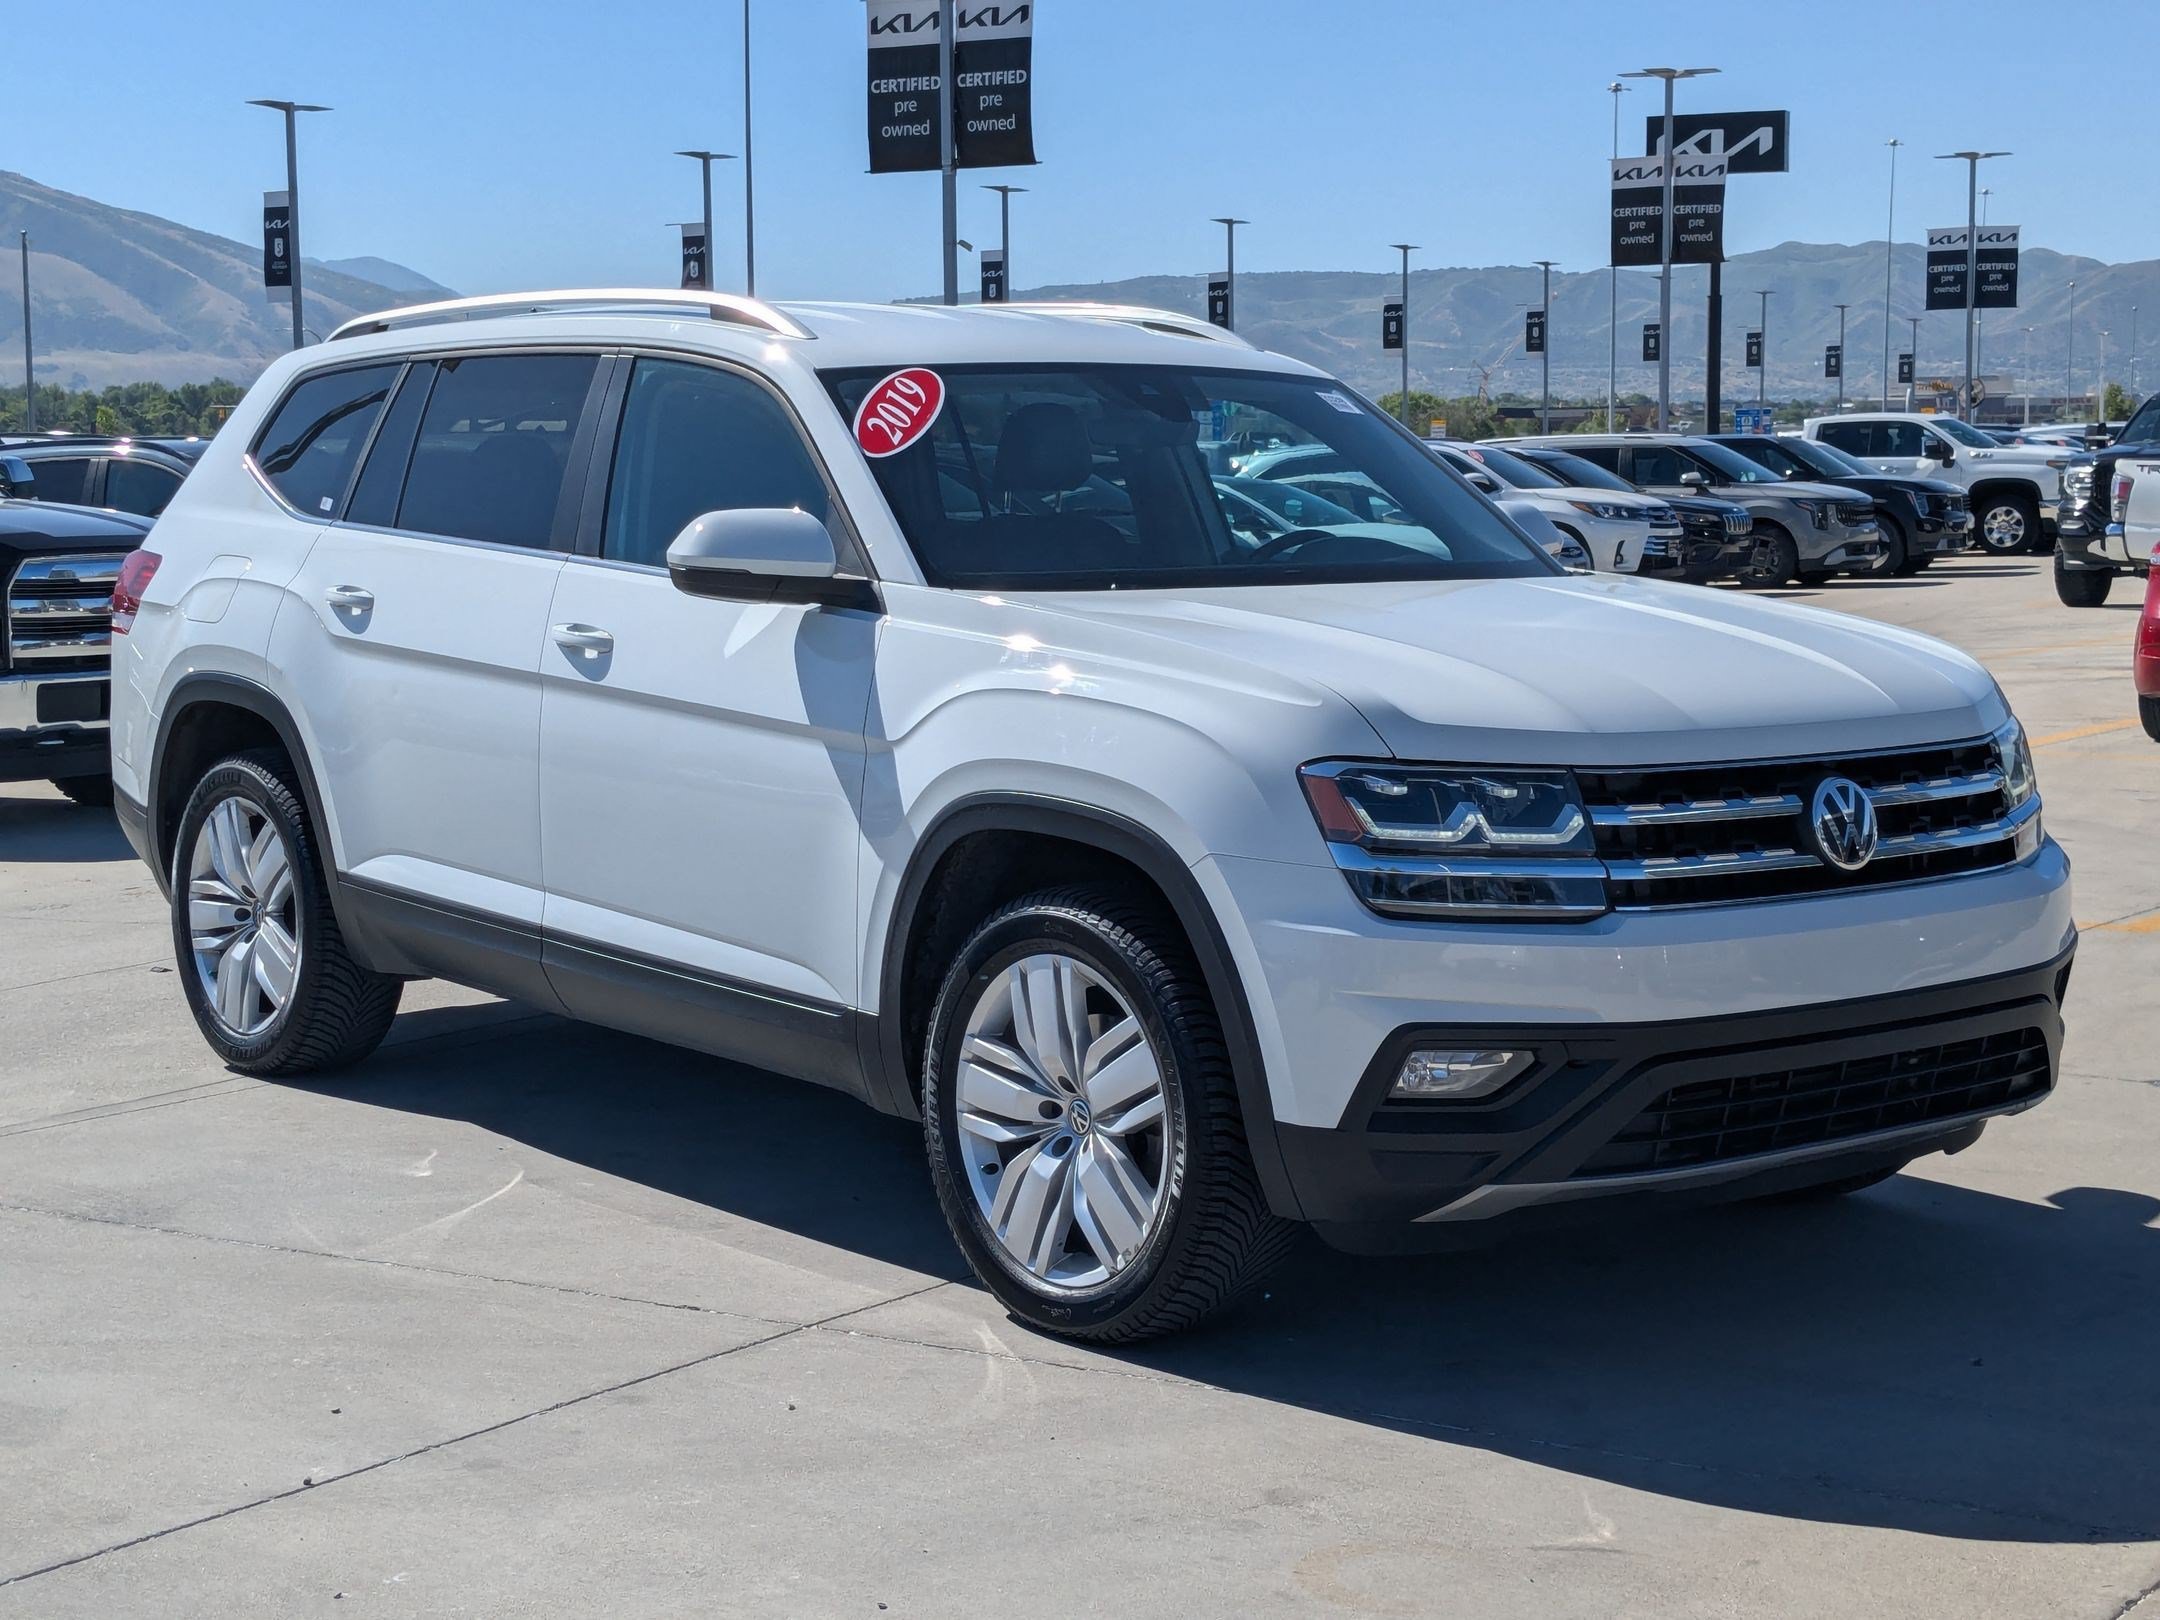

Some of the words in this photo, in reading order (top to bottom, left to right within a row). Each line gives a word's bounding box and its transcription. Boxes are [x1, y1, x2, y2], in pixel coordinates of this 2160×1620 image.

[958, 4, 1030, 29] KIA
[957, 69, 1027, 88] CERTIFIED
[870, 76, 941, 94] CERTIFIED
[894, 99, 918, 117] pre
[979, 93, 1003, 111] pre
[881, 119, 930, 138] owned
[967, 114, 1016, 133] owned
[1613, 205, 1663, 218] CERTIFIED
[1673, 203, 1722, 214] CERTIFIED
[1629, 220, 1646, 232] pre
[1688, 218, 1705, 229] pre
[1620, 233, 1655, 245] owned
[1680, 231, 1714, 243] owned
[1928, 263, 1968, 273] CERTIFIED
[1976, 262, 2016, 271] CERTIFIED
[1941, 275, 1955, 283] pre
[1989, 273, 2002, 281] pre
[1933, 284, 1961, 294] owned
[1981, 283, 2009, 292] owned
[866, 377, 926, 446] 2019
